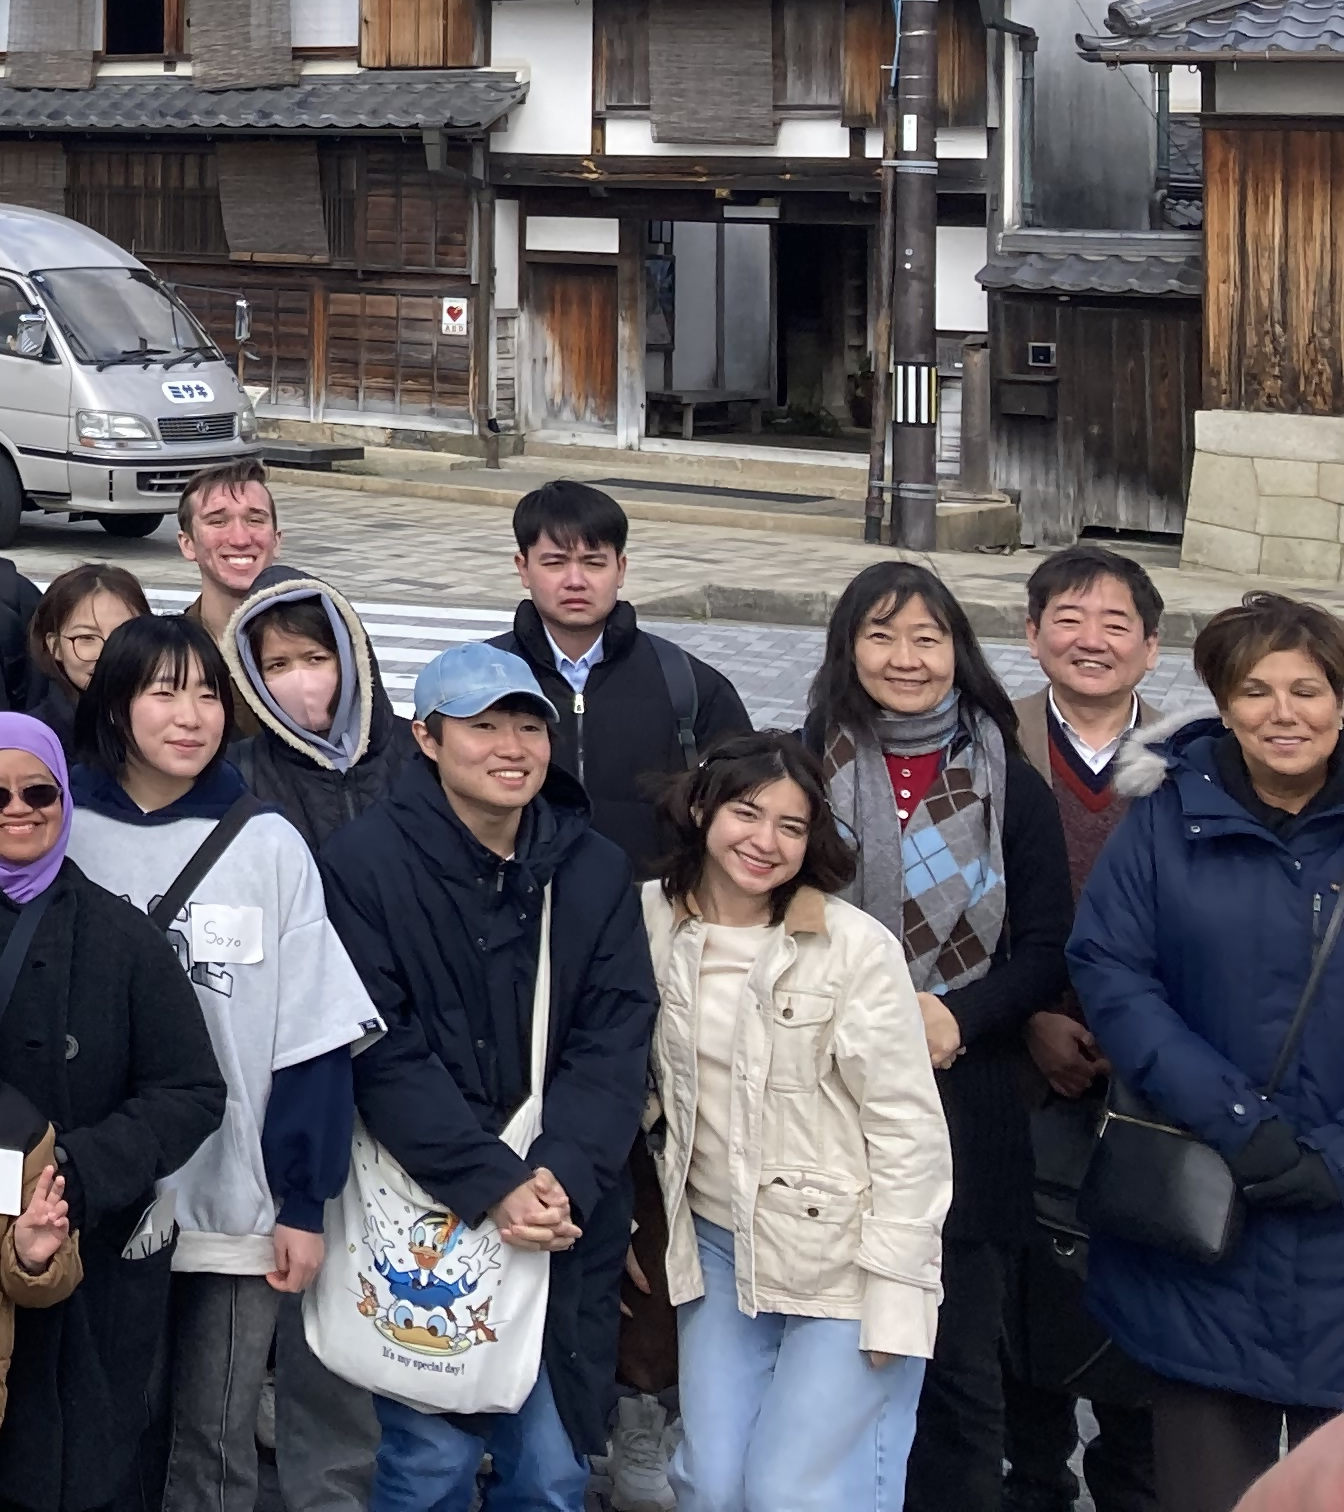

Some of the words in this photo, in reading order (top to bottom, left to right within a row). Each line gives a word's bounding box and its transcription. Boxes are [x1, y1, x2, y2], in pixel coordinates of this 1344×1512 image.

[168, 384, 208, 399] ミサキ
[204, 920, 241, 947] Soyo
[382, 1345, 395, 1360] It's
[397, 1354, 412, 1367] my
[413, 1359, 443, 1373] special
